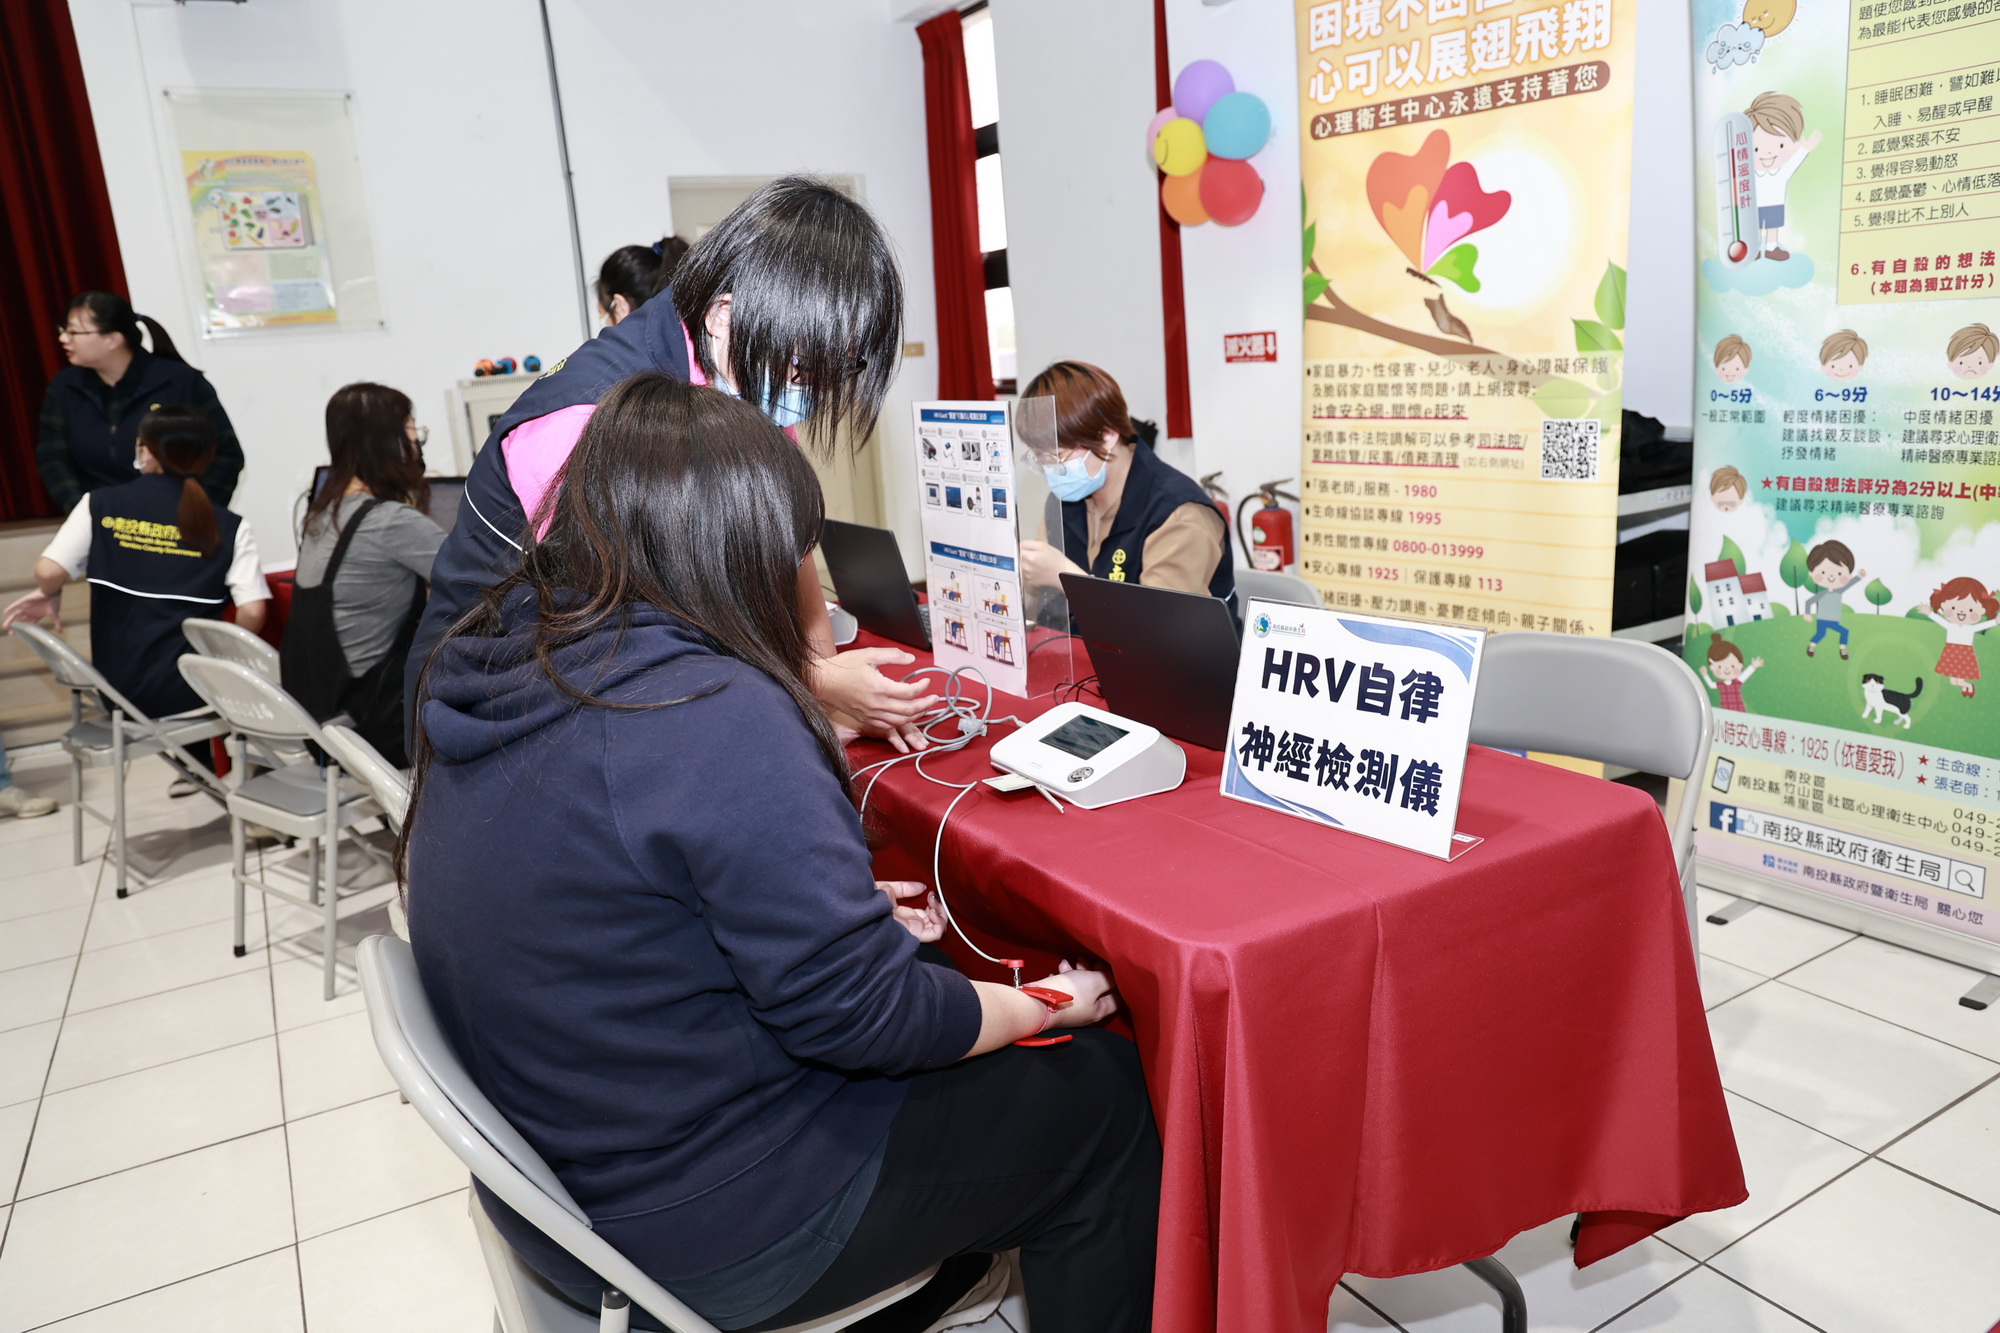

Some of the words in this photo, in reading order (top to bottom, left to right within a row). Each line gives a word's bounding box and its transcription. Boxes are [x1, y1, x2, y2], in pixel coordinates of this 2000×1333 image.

[1309, 0, 1612, 104] 心可以展翅飛翔
[1874, 68, 2000, 105] 睡眠困難，譬如難
[1314, 65, 1600, 139] 心理衛生中心永遠支持著您
[1873, 96, 1993, 130] 入睡、易醒或早醒
[1872, 128, 1960, 154] 感覺緊張不安
[1871, 153, 1958, 179] 覺得容易動怒
[1869, 172, 2000, 203] 感覺憂鬱、心情低落
[1868, 202, 1969, 227] 覺得比不上別人
[1701, 409, 1766, 424] 一般正常範圍
[1903, 409, 1993, 426] 中度情緒困擾
[1901, 429, 2000, 446] 建議尋求心理衛
[1781, 446, 1836, 461] 抒發情緒
[1901, 448, 2000, 467] 精神醫療專業諮
[1404, 484, 1438, 498] 1980
[1776, 475, 2000, 502] 有自殺想法評分為2分以上(中
[1312, 505, 1404, 523] 生命線協談專線
[1409, 511, 1442, 525] 1995
[1775, 497, 1945, 521] 建議尋求精神醫療專業諮詢
[1312, 532, 1389, 551] 男性關懷專線
[1393, 539, 1484, 559] 0800-013999
[1312, 560, 1362, 577] 安心專線
[1368, 566, 1399, 581] 1925
[1414, 569, 1472, 590] 保護專線
[1478, 577, 1503, 592] 113
[1317, 588, 1595, 635] 緒困擾、壓力調適、憂鬱症傾向、親子關係、
[1261, 647, 1444, 724] HRV自律
[1239, 721, 1443, 817] 神經檢測儀
[1785, 769, 1827, 788] 南投區
[1936, 756, 2000, 782] 生命線：
[1738, 775, 1781, 796] 南投縣
[1784, 782, 1825, 801] 竹山區
[1828, 794, 1949, 835] 社區心理衛生中心
[1762, 819, 1941, 883] 南投縣政府衛生局
[1802, 864, 1929, 910] 南投縣政府暨衛生局
[1937, 901, 1984, 926] 關心您
